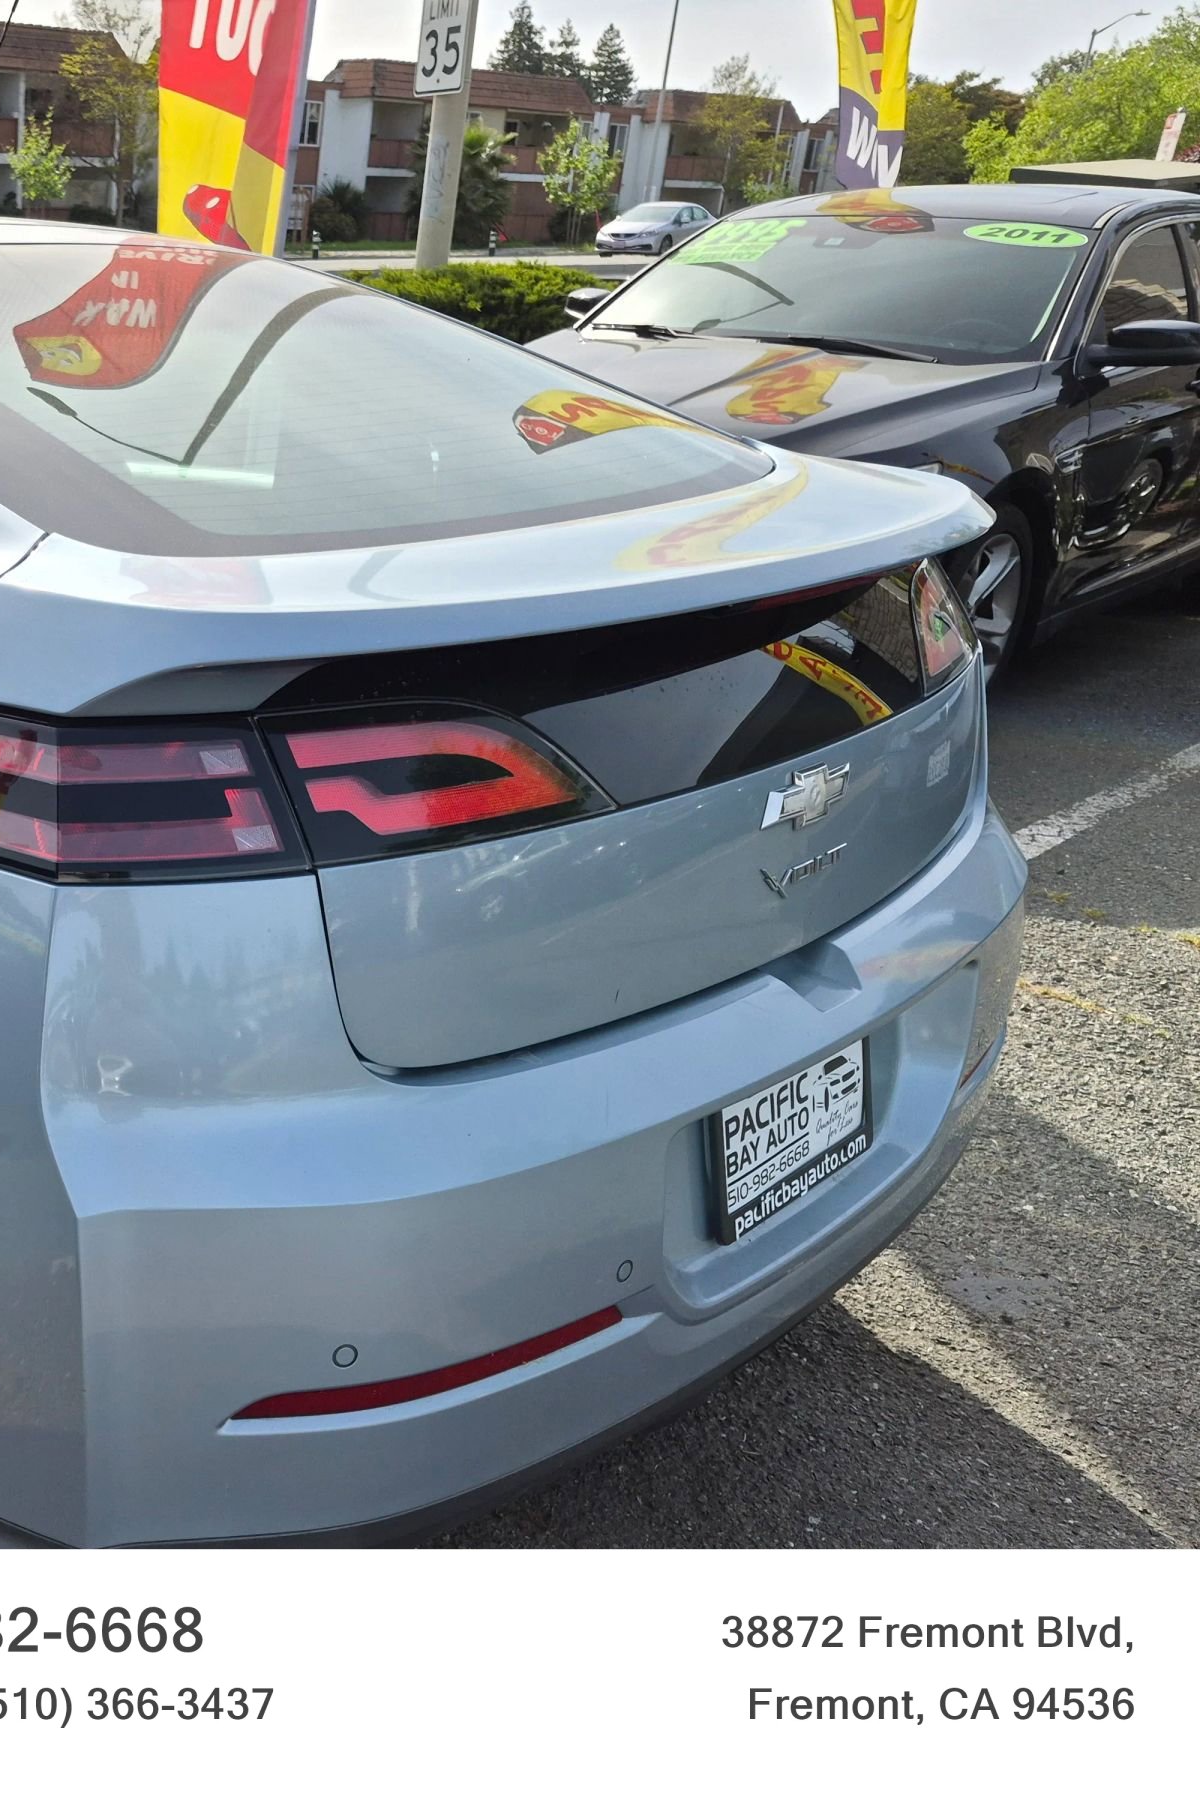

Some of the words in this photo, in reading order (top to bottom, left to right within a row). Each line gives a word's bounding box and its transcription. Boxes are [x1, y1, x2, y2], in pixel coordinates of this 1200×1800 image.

[422, 25, 461, 77] 35
[979, 227, 1069, 243] 2011
[760, 842, 847, 898] VOLT
[724, 1072, 809, 1150] PACIFIC
[815, 1109, 842, 1134] Quality
[826, 1126, 837, 1147] for
[726, 1140, 758, 1178] BAY
[766, 1106, 809, 1153] AUTO
[728, 1140, 810, 1208] 510-982-6668
[734, 1134, 867, 1240] pacificbayauto.com
